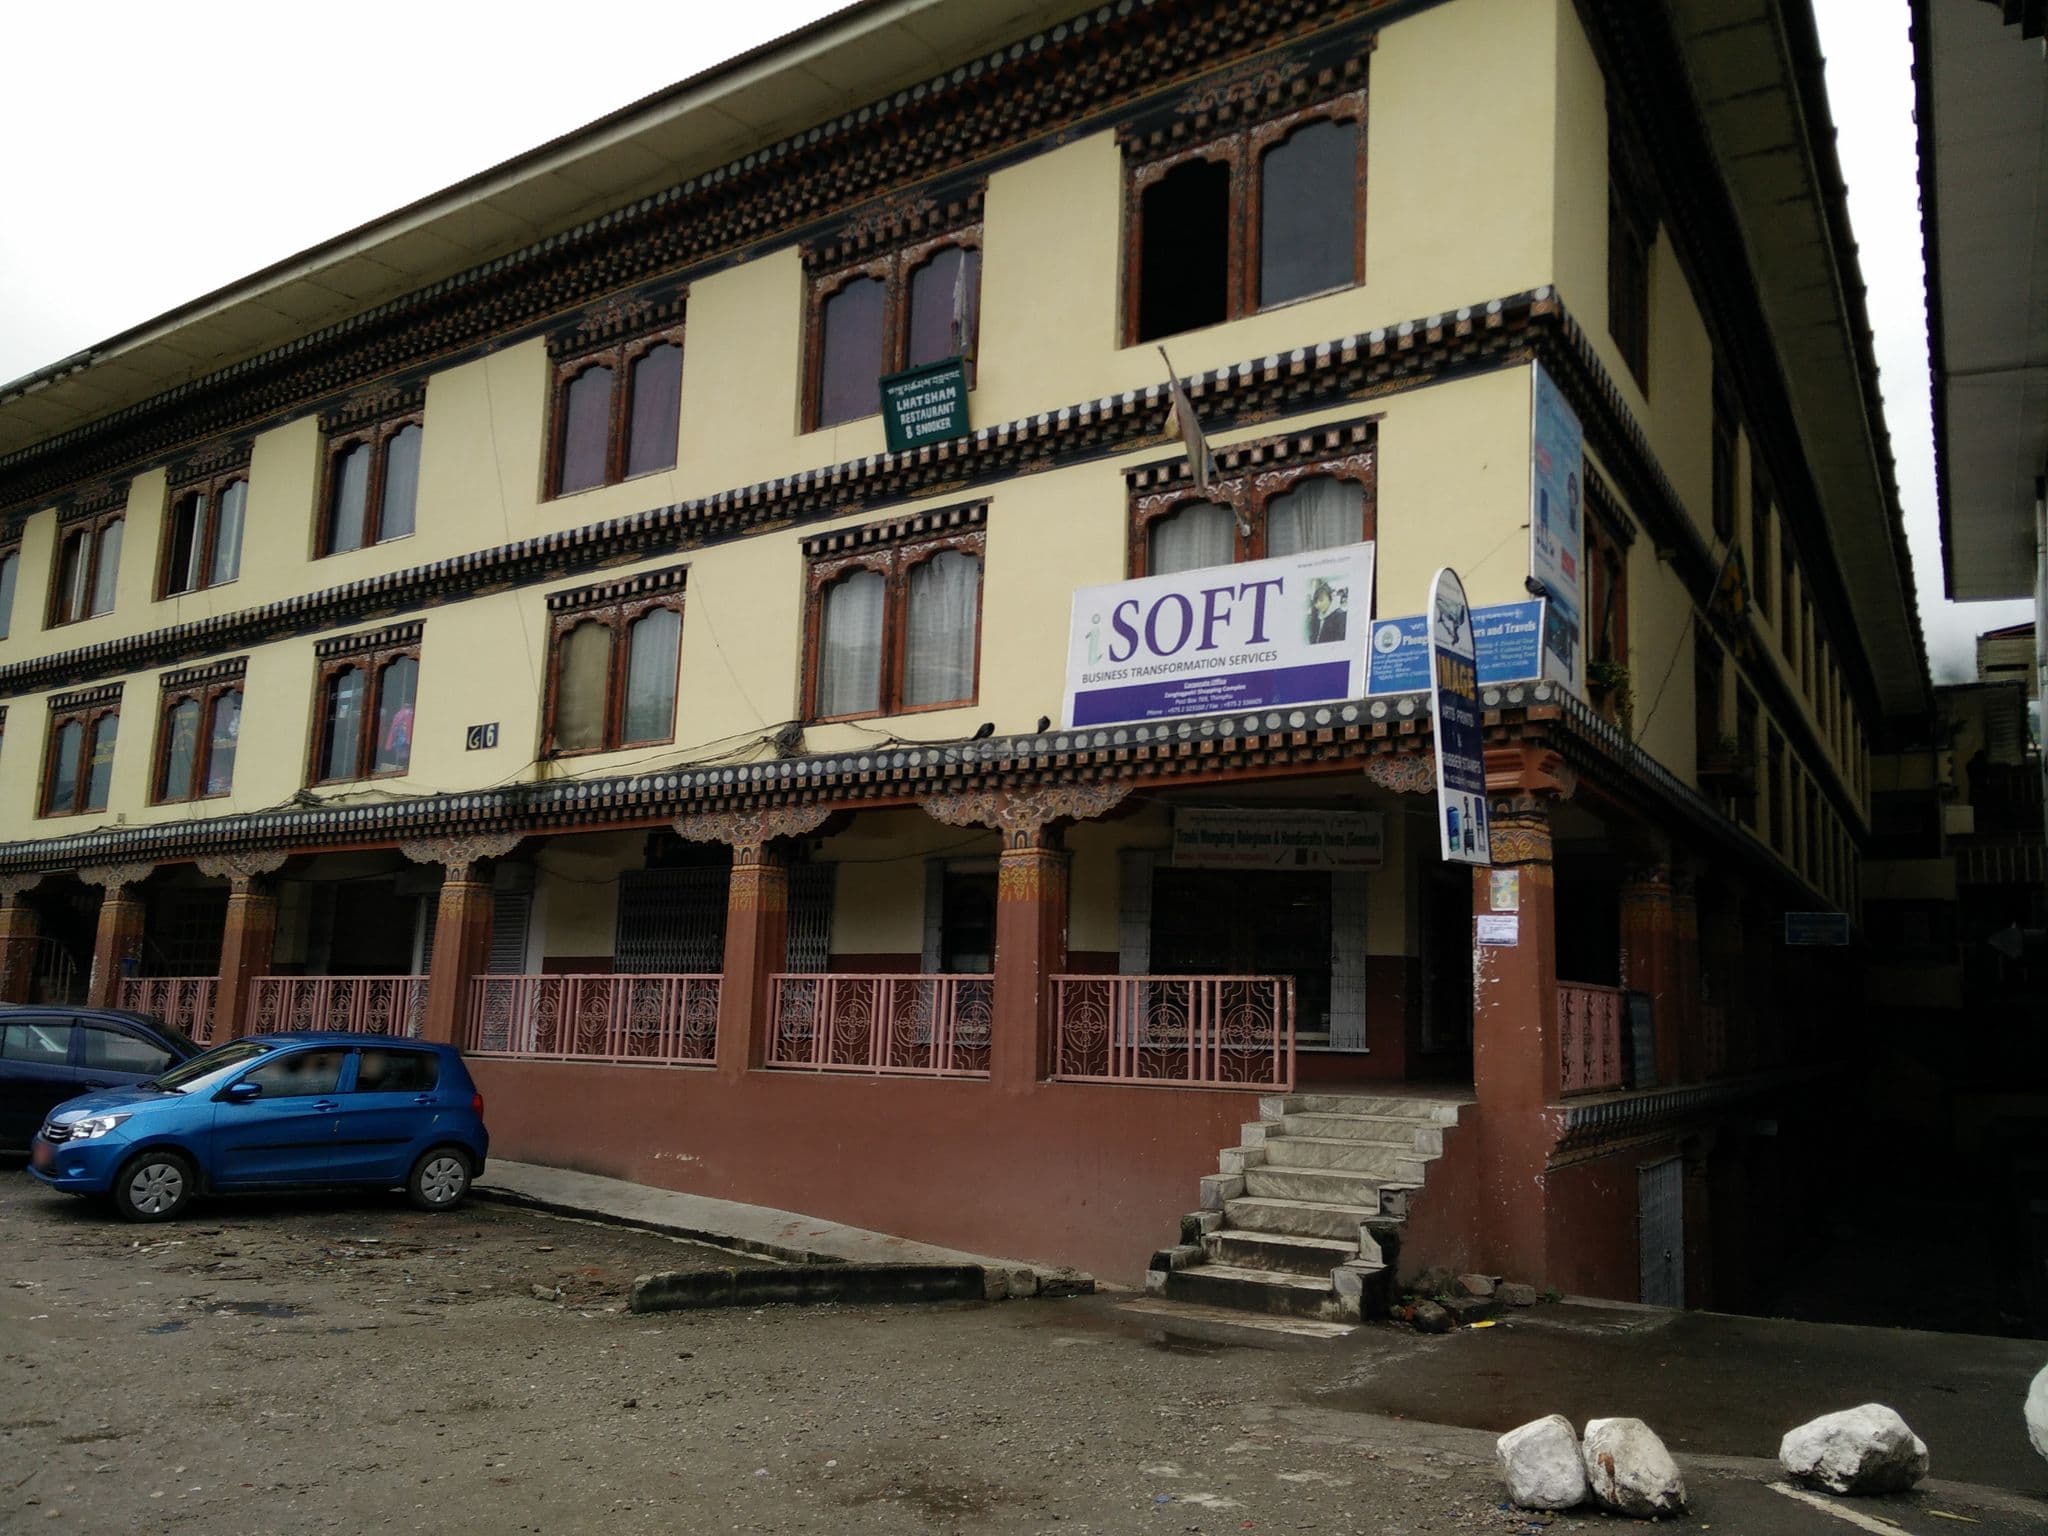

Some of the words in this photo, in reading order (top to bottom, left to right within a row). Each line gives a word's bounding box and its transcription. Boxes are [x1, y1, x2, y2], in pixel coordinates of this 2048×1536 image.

[896, 386, 956, 412] LHATSHAM
[900, 401, 955, 425] RESTAURANT
[915, 417, 952, 436] SNOOKER
[1487, 624, 1504, 636] and
[1505, 620, 1537, 635] Travels
[1082, 670, 1128, 684] BUSINESS
[1131, 656, 1226, 678] TRANSFORMATION
[1229, 650, 1278, 667] SERVICES
